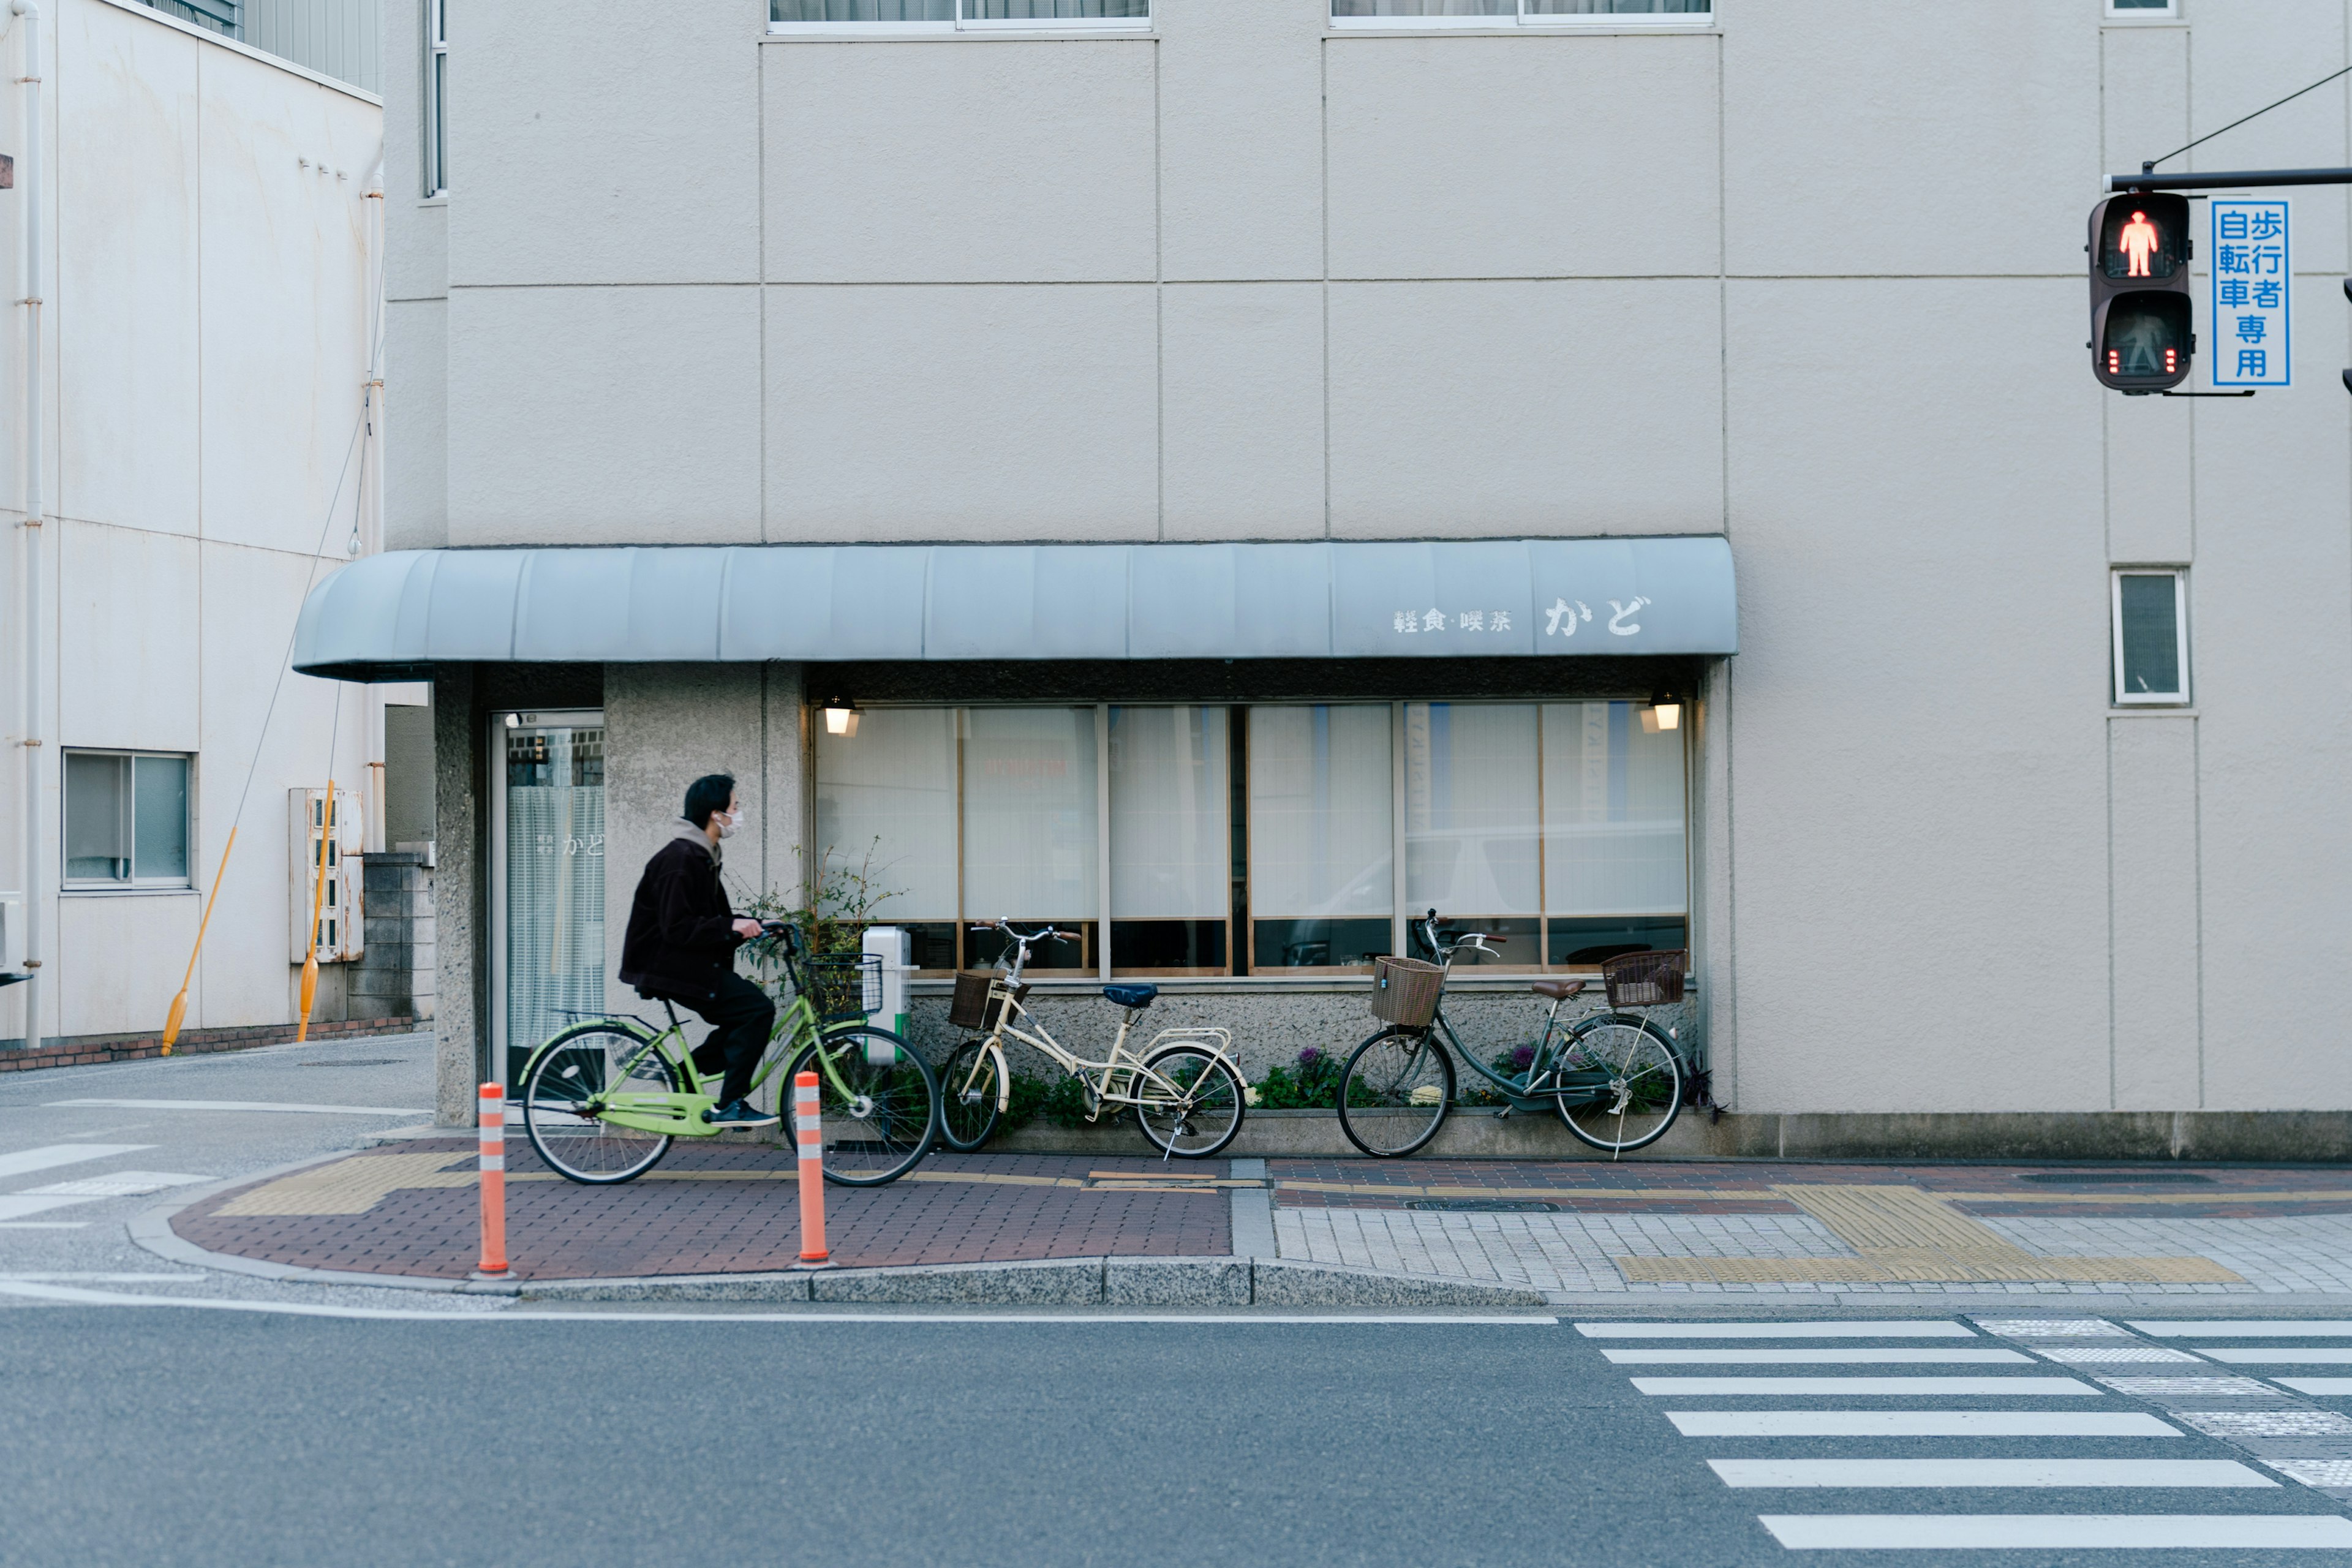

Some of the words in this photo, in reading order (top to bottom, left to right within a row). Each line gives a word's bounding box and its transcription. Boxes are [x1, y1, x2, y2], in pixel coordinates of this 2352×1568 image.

[2219, 211, 2250, 309] 自転車
[2252, 211, 2282, 309] 歩行者
[2236, 314, 2267, 377] 専用
[1545, 596, 1652, 637] かど
[563, 833, 605, 856] かど
